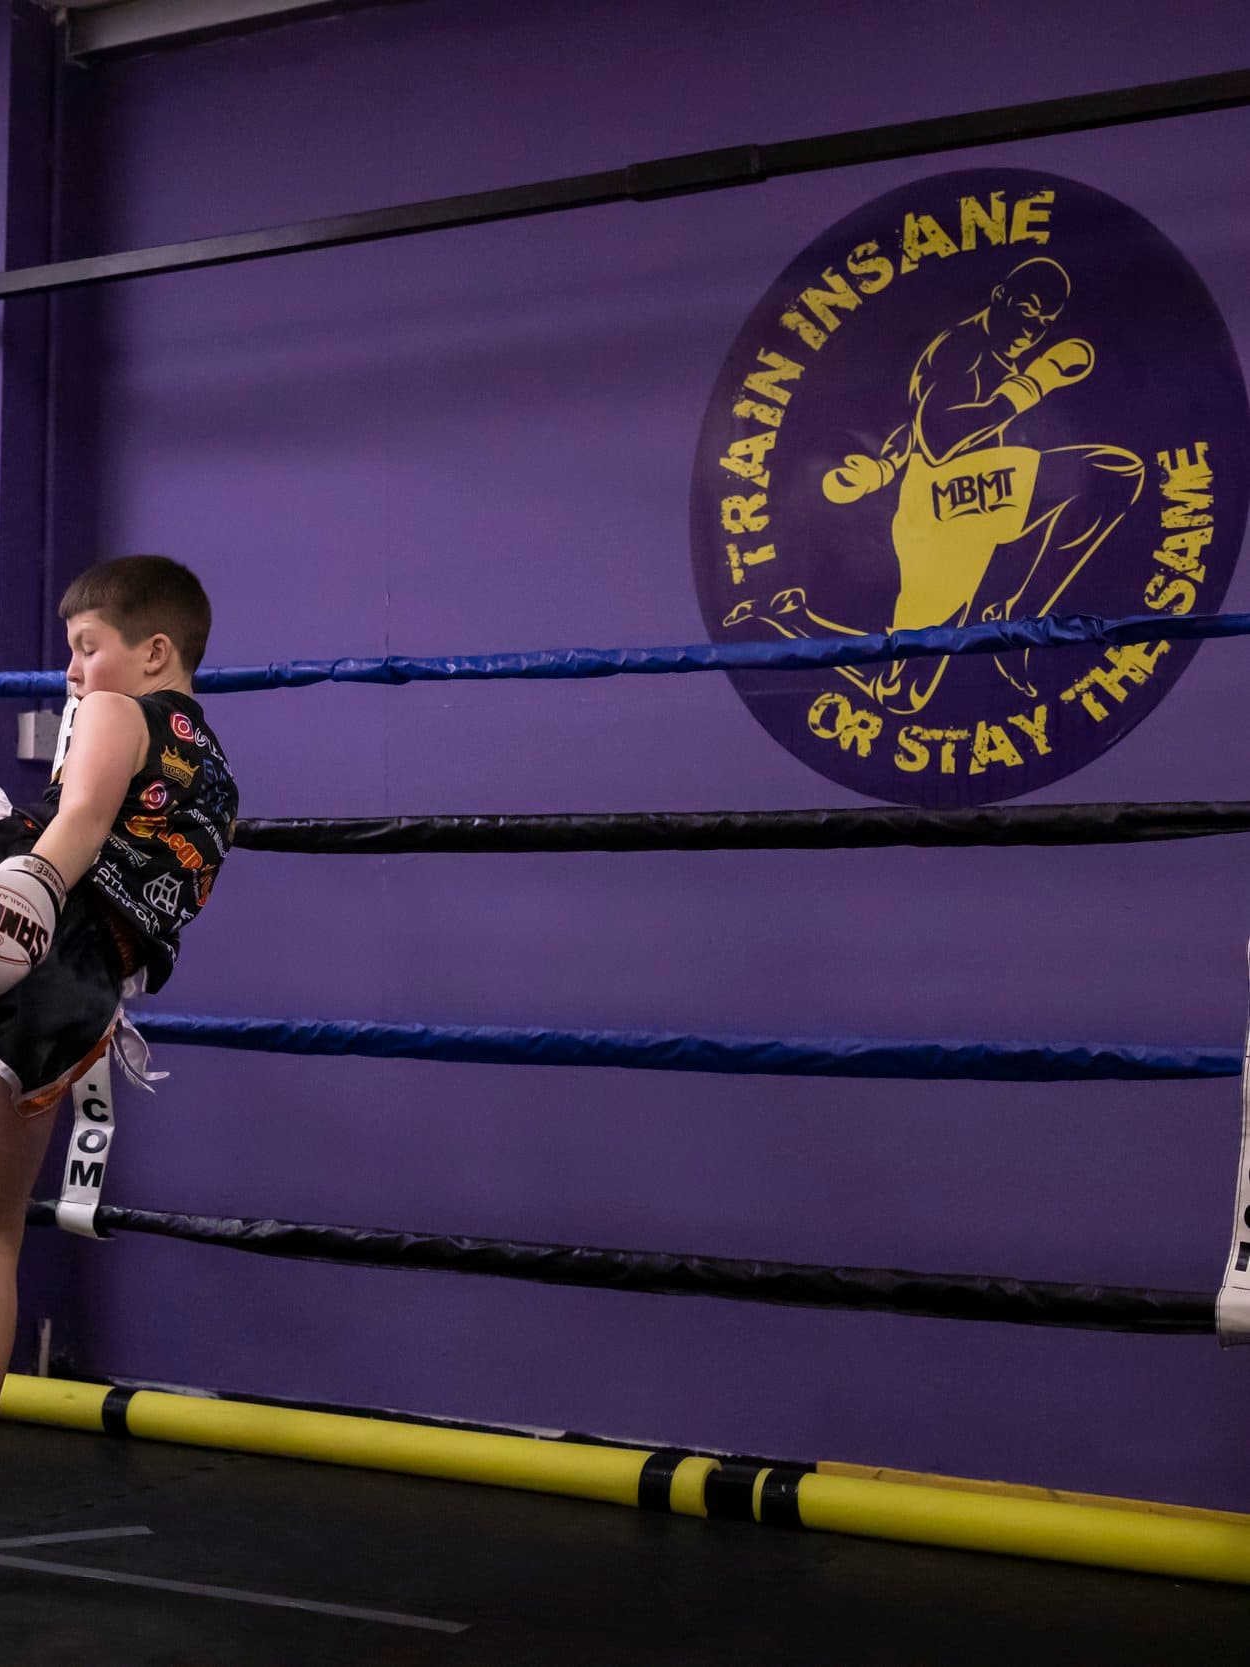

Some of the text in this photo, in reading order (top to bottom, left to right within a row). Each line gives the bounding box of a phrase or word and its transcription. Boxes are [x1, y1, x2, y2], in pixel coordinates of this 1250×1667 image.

[720, 190, 1056, 585] TRAIN INSANE
[931, 467, 1016, 521] MBMT
[807, 693, 880, 757] OR
[893, 703, 1052, 775] STAY
[1144, 440, 1214, 615] SAME
[69, 1084, 109, 1188] .COM
